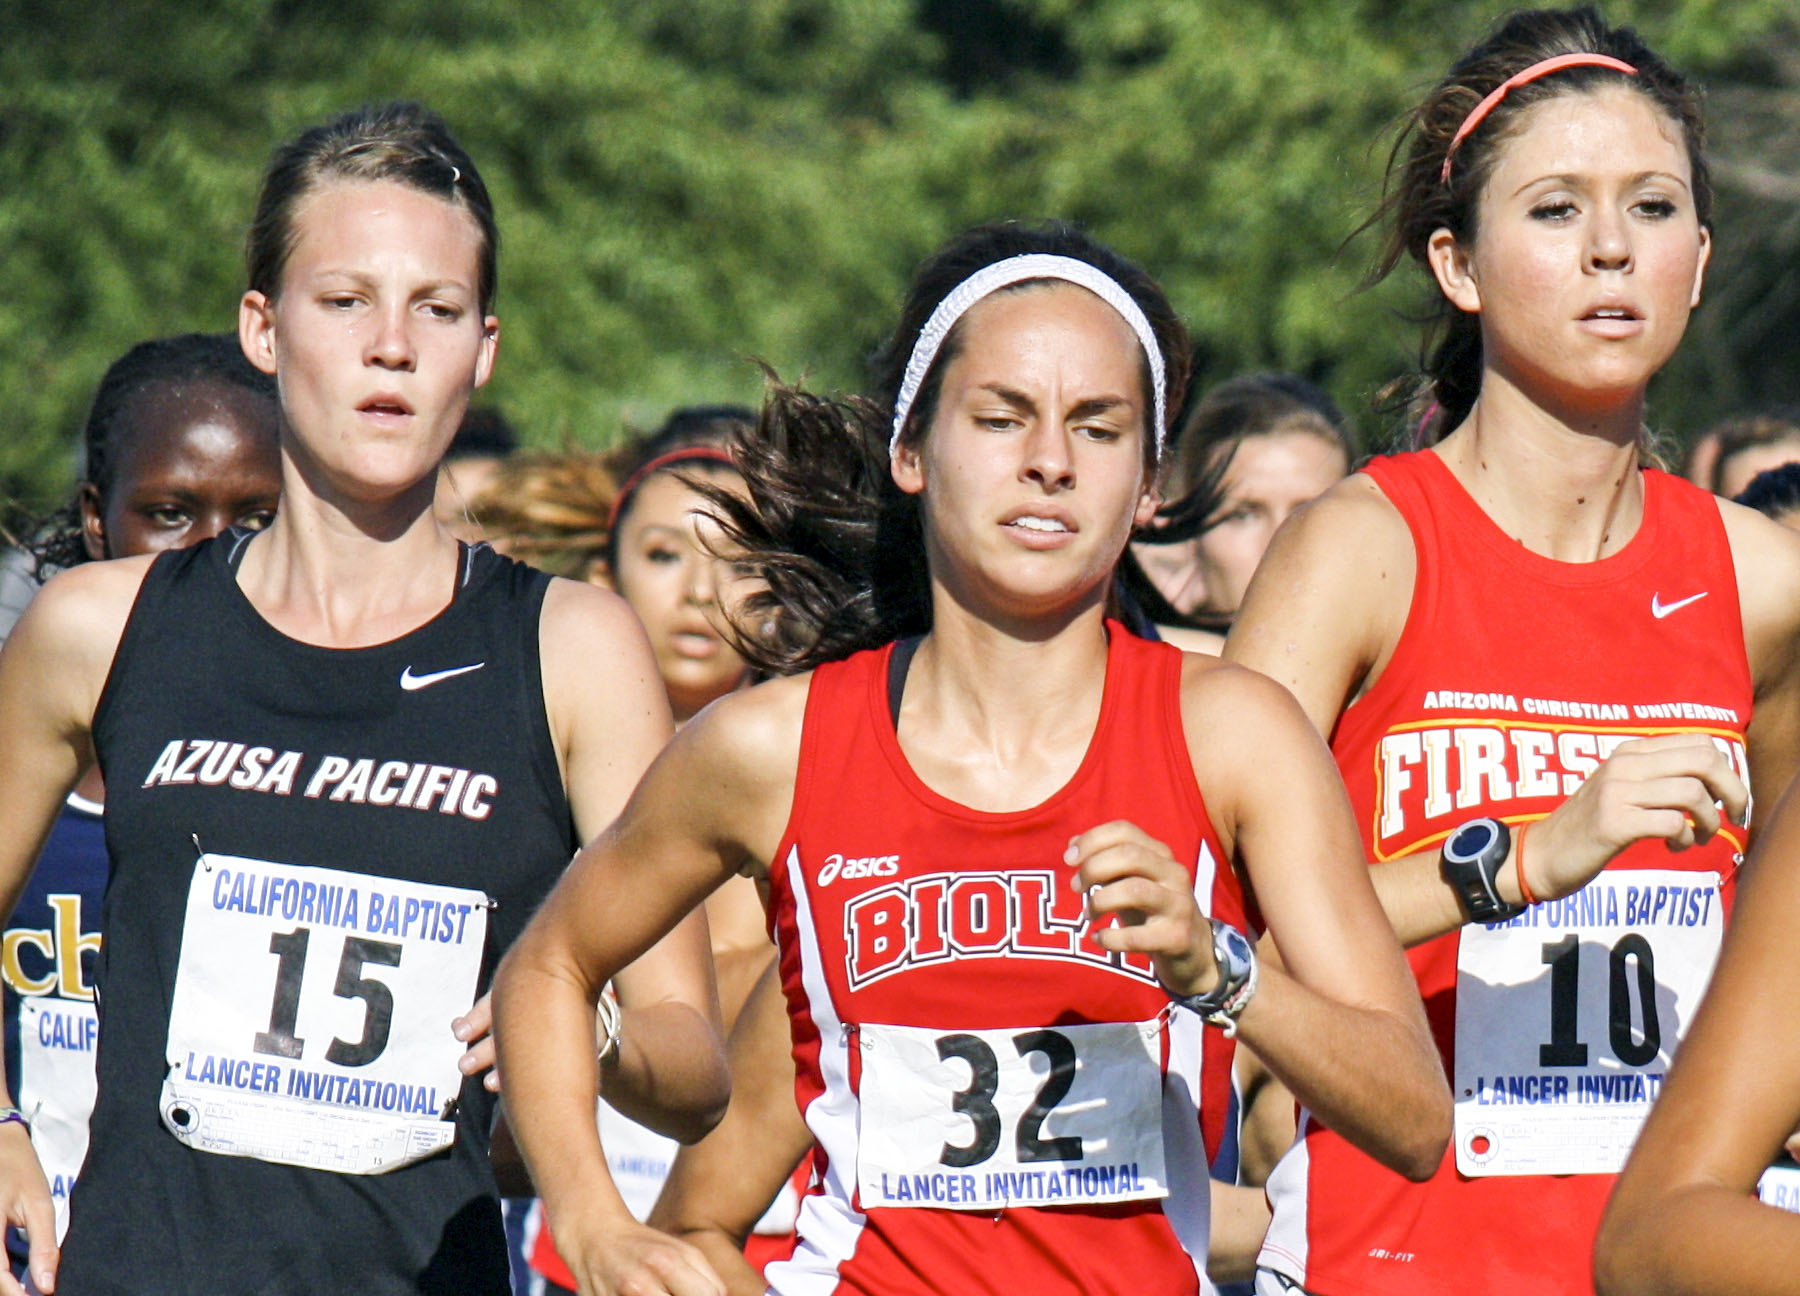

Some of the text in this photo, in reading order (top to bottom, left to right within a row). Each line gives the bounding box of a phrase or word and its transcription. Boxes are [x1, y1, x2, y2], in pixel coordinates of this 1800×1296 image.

[1423, 691, 1739, 724] ARIZONA CHRISTIAN UNIVERSITY
[141, 739, 499, 821] AZUSA PACIFIC
[1382, 726, 1753, 840] FIRES
[841, 854, 899, 880] asics
[213, 868, 472, 945] CALIFORNIA BAPTIST
[1485, 886, 1715, 931] IFORNIA BAPTIST
[252, 927, 404, 1068] 15
[1539, 932, 1661, 1068] 10
[185, 1050, 280, 1094] LANCER
[287, 1072, 440, 1116] INVITATIONAL
[936, 1029, 1083, 1168] 32
[1477, 1075, 1569, 1106] LANCER
[881, 1162, 1145, 1202] LANCER INVITATIONAL
[1368, 1248, 1415, 1262] DRI-FIT
